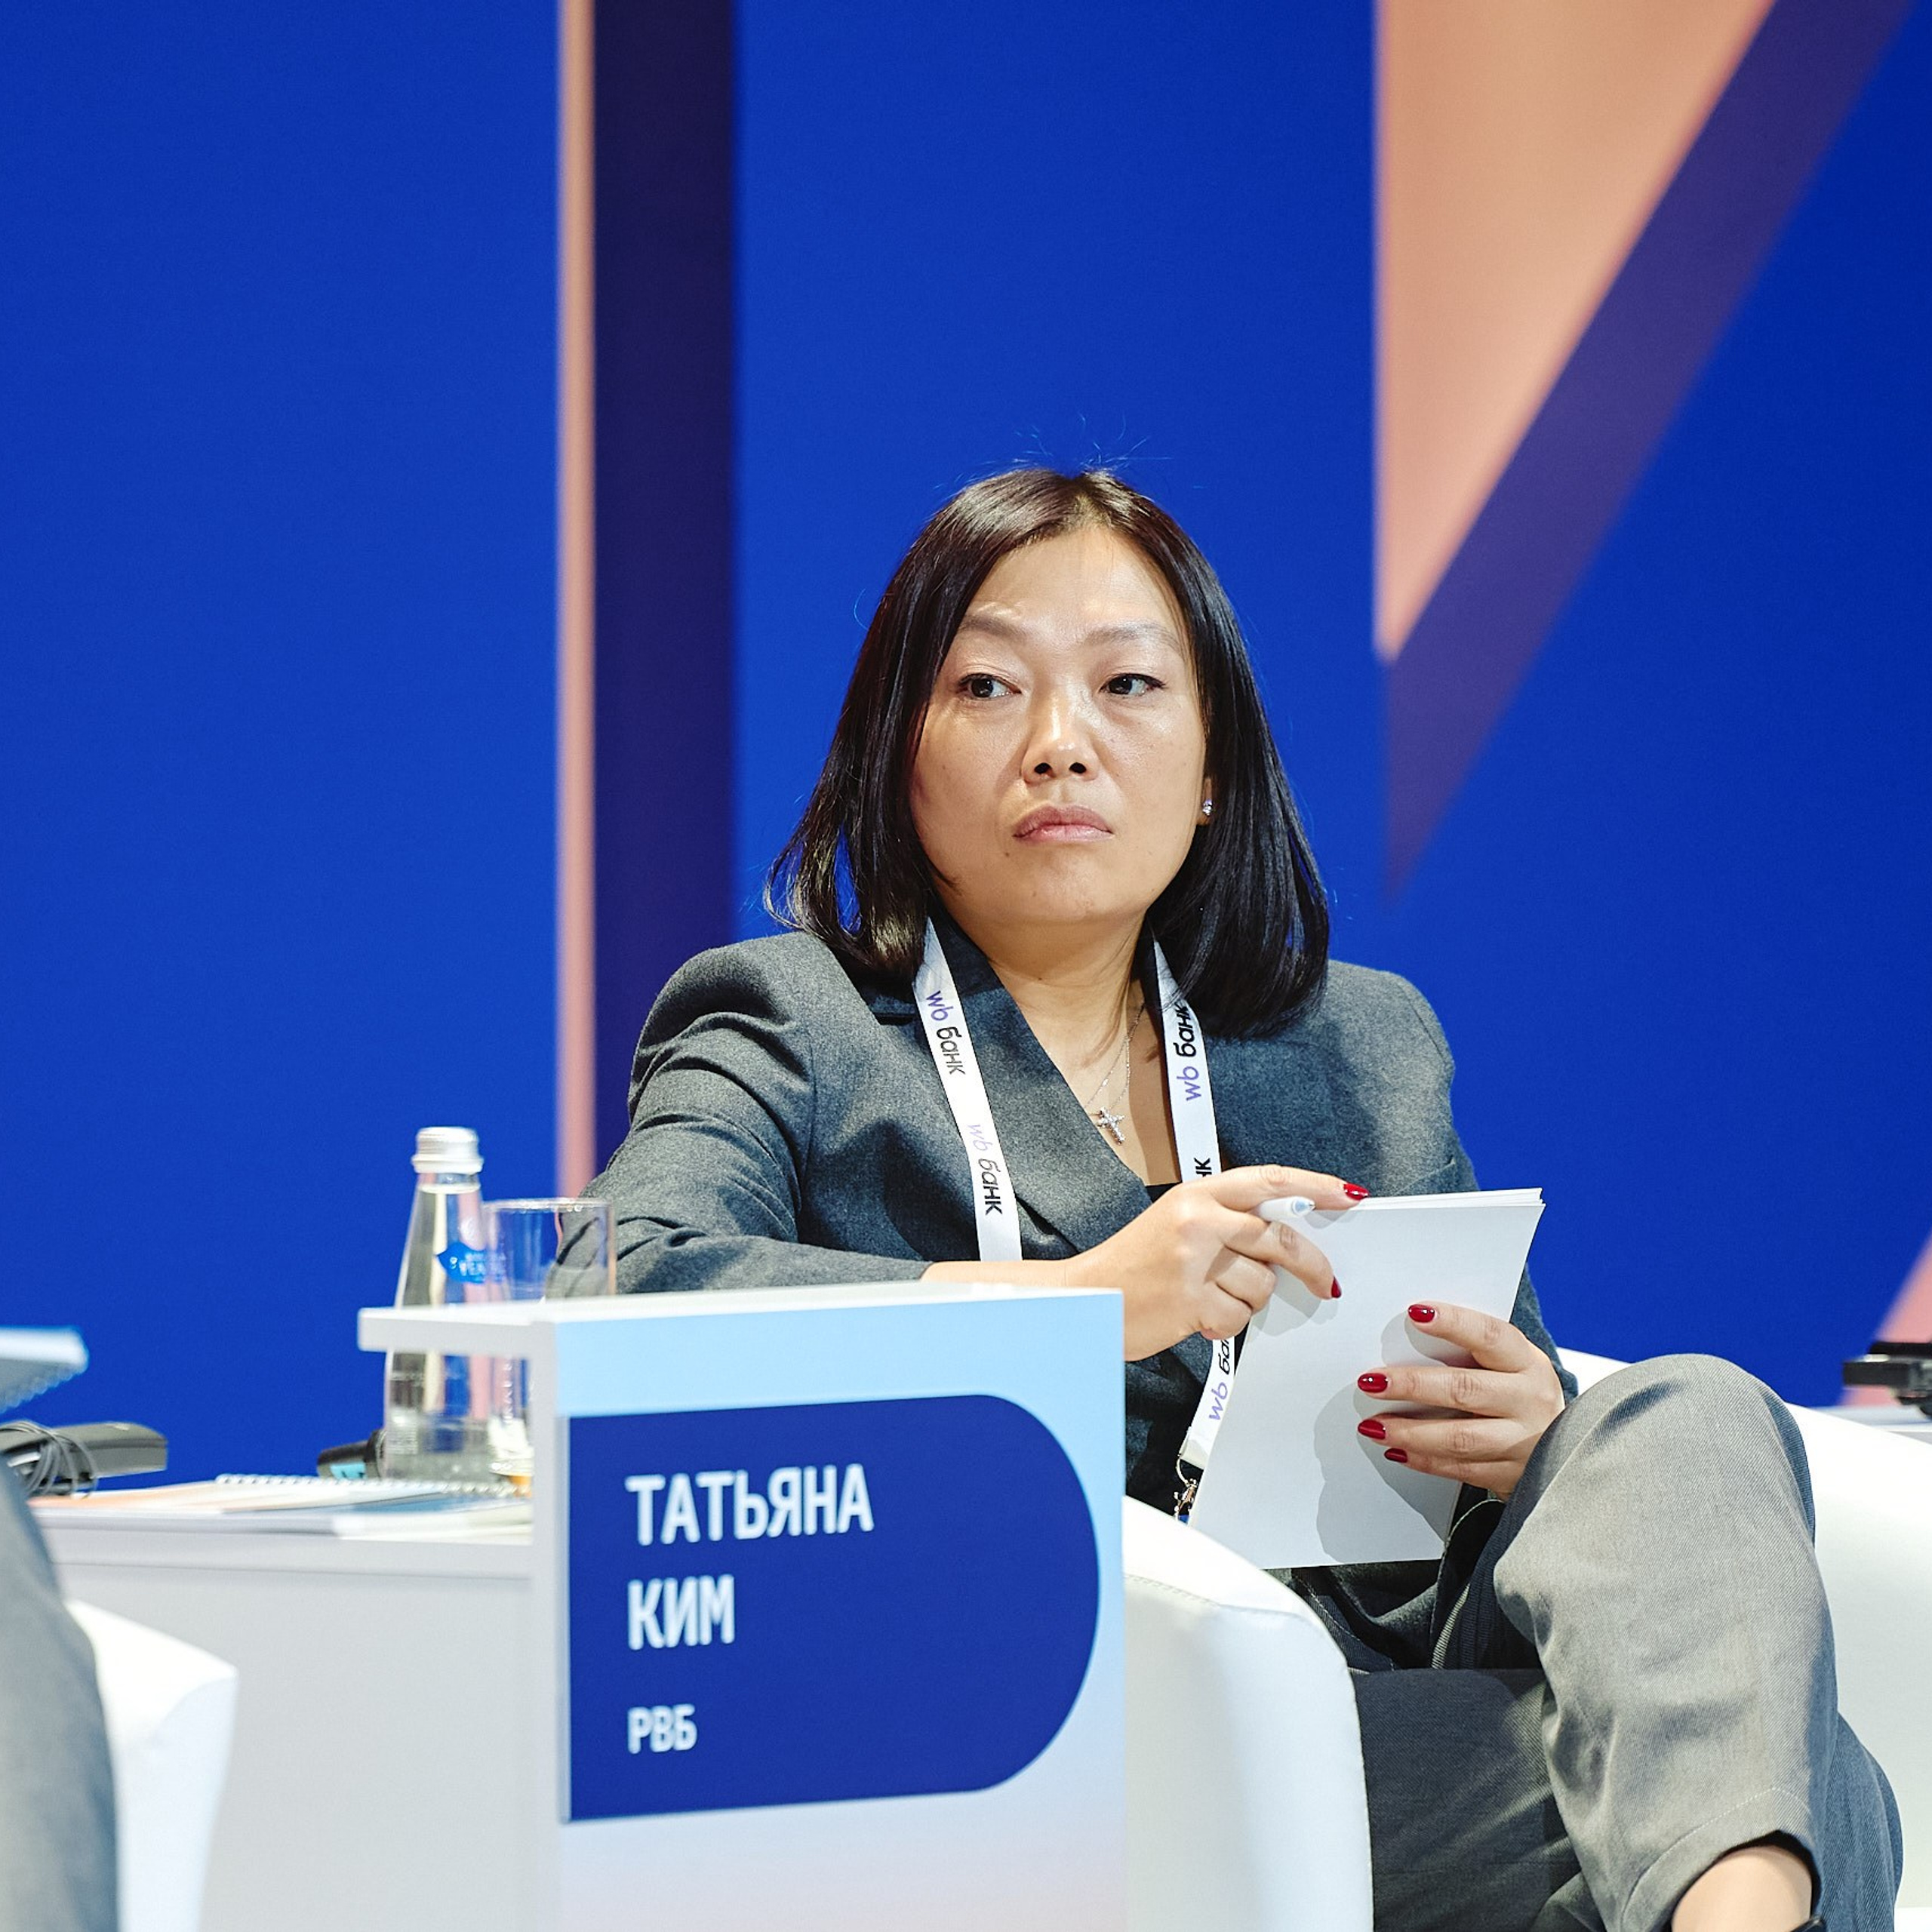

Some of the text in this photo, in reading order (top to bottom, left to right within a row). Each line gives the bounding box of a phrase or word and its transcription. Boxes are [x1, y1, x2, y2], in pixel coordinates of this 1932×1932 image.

[926, 990, 966, 1075] wb банк
[1174, 1001, 1201, 1101] wb банк
[968, 1124, 1003, 1216] wb банк
[1209, 1340, 1230, 1420] wb ба
[625, 1463, 875, 1546] ТАТЬЯНА
[627, 1574, 735, 1651] КИМ
[627, 1703, 697, 1755] РВБ
